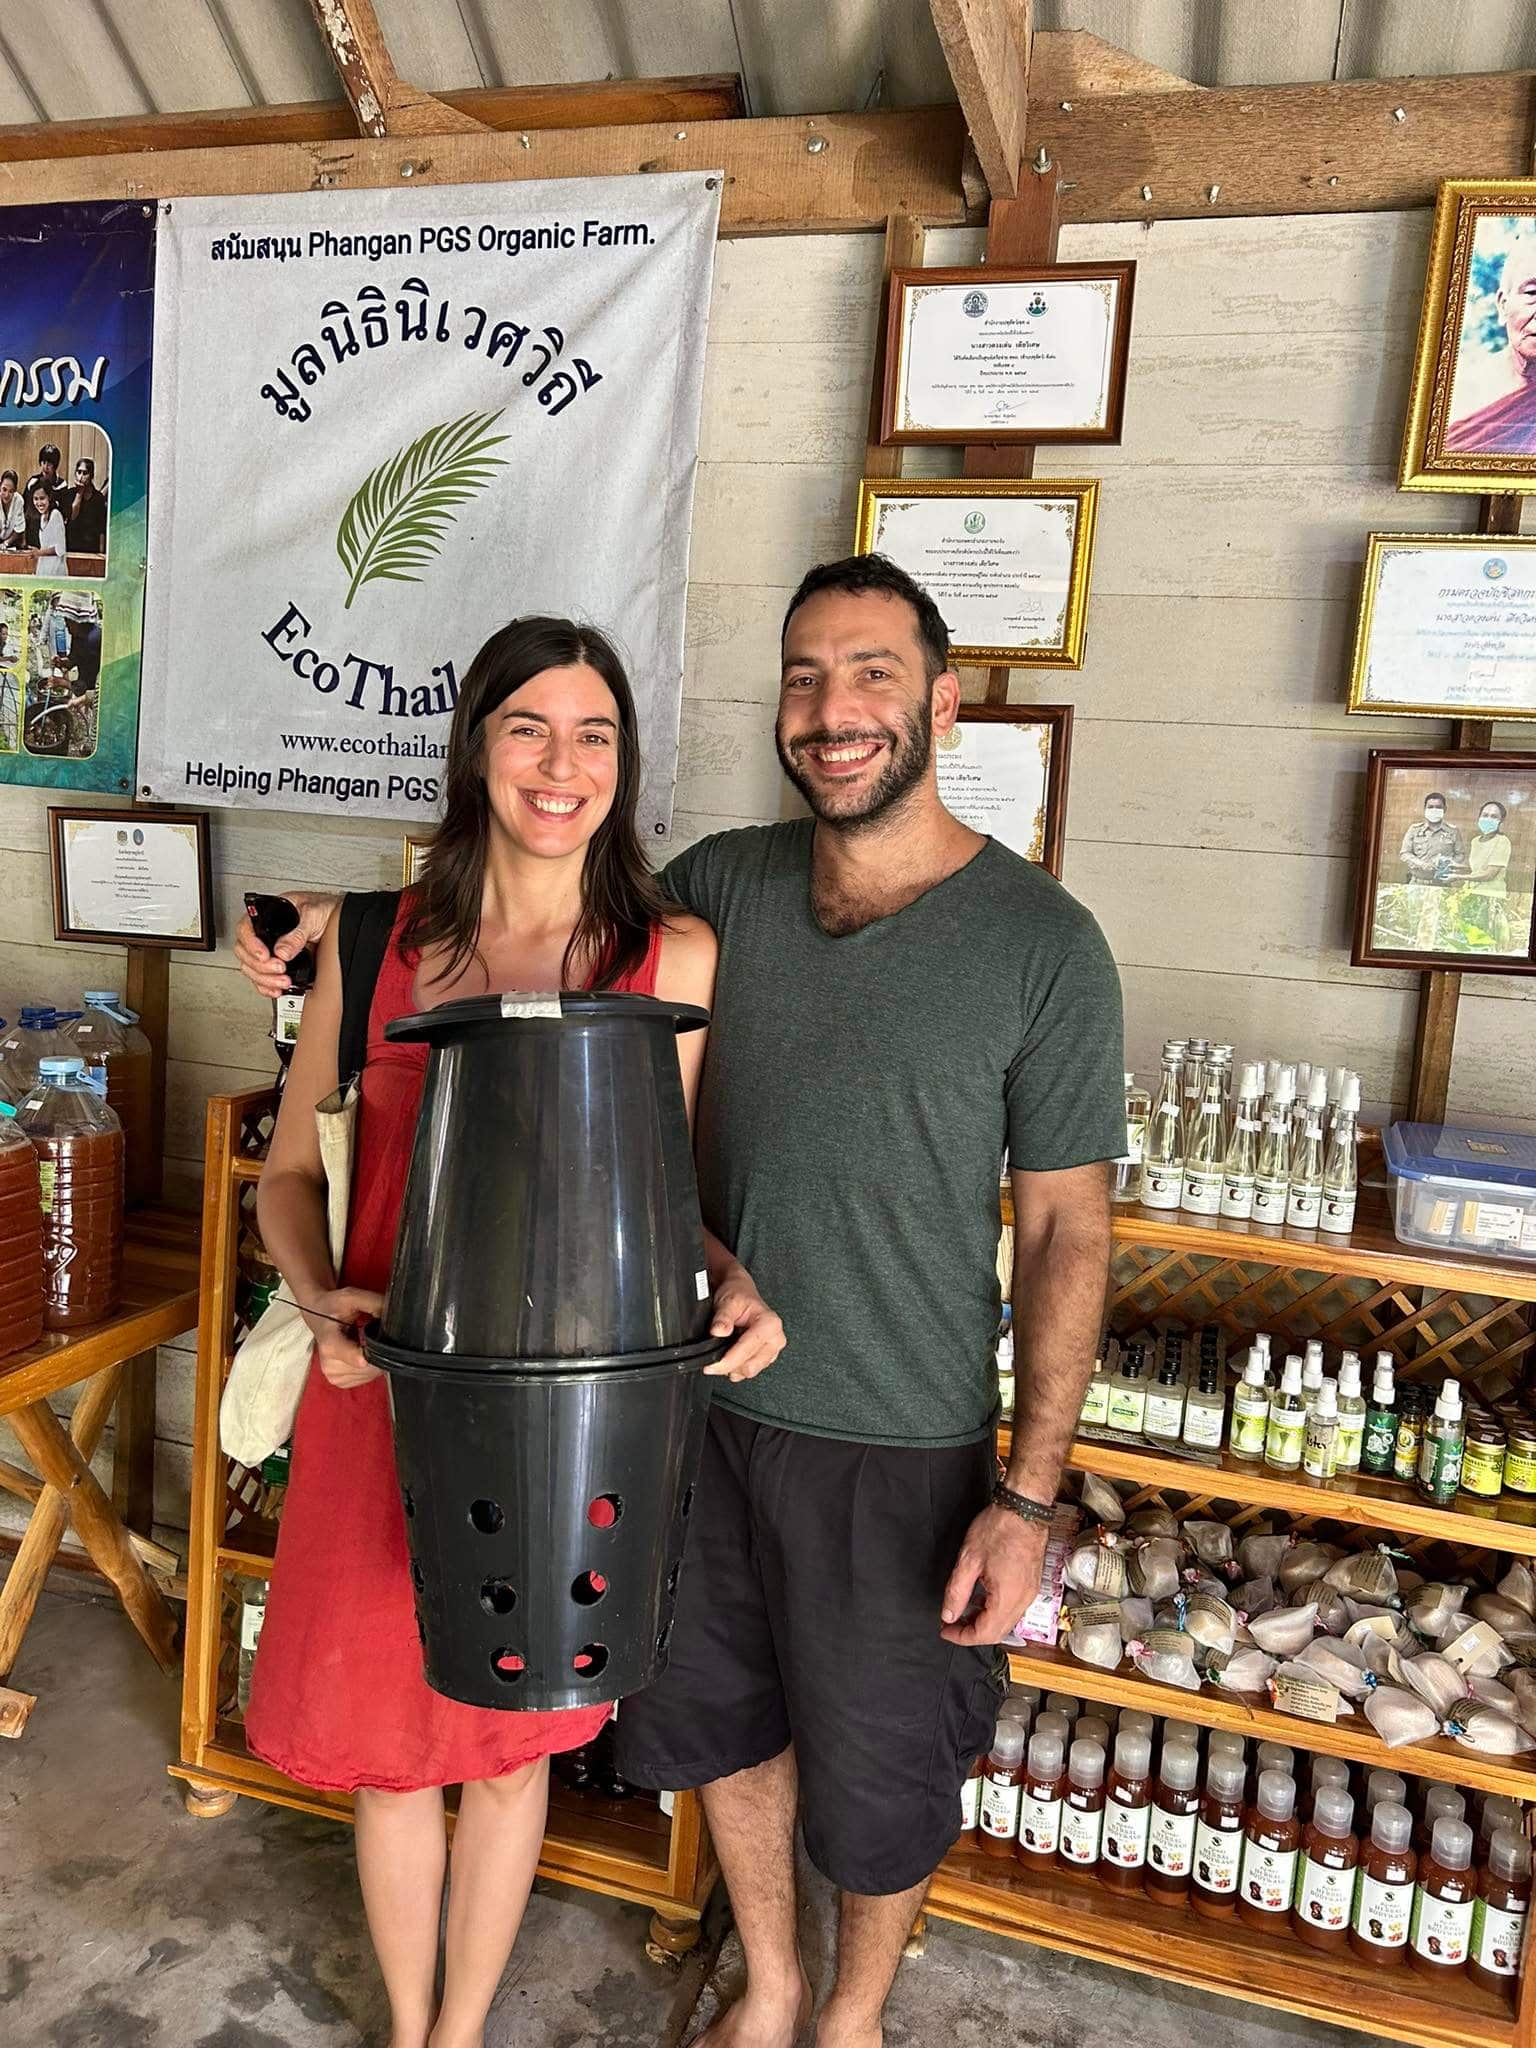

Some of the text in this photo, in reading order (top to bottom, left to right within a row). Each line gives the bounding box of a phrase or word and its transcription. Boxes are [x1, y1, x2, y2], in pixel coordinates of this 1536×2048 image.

[211, 220, 656, 262] สนับสนุน Phangan PGS Organic Farm.
[261, 277, 603, 422] มูลนิธินิเวศวิถี
[261, 601, 460, 717] EcoThail
[185, 762, 439, 802] Helping Phangan PGS
